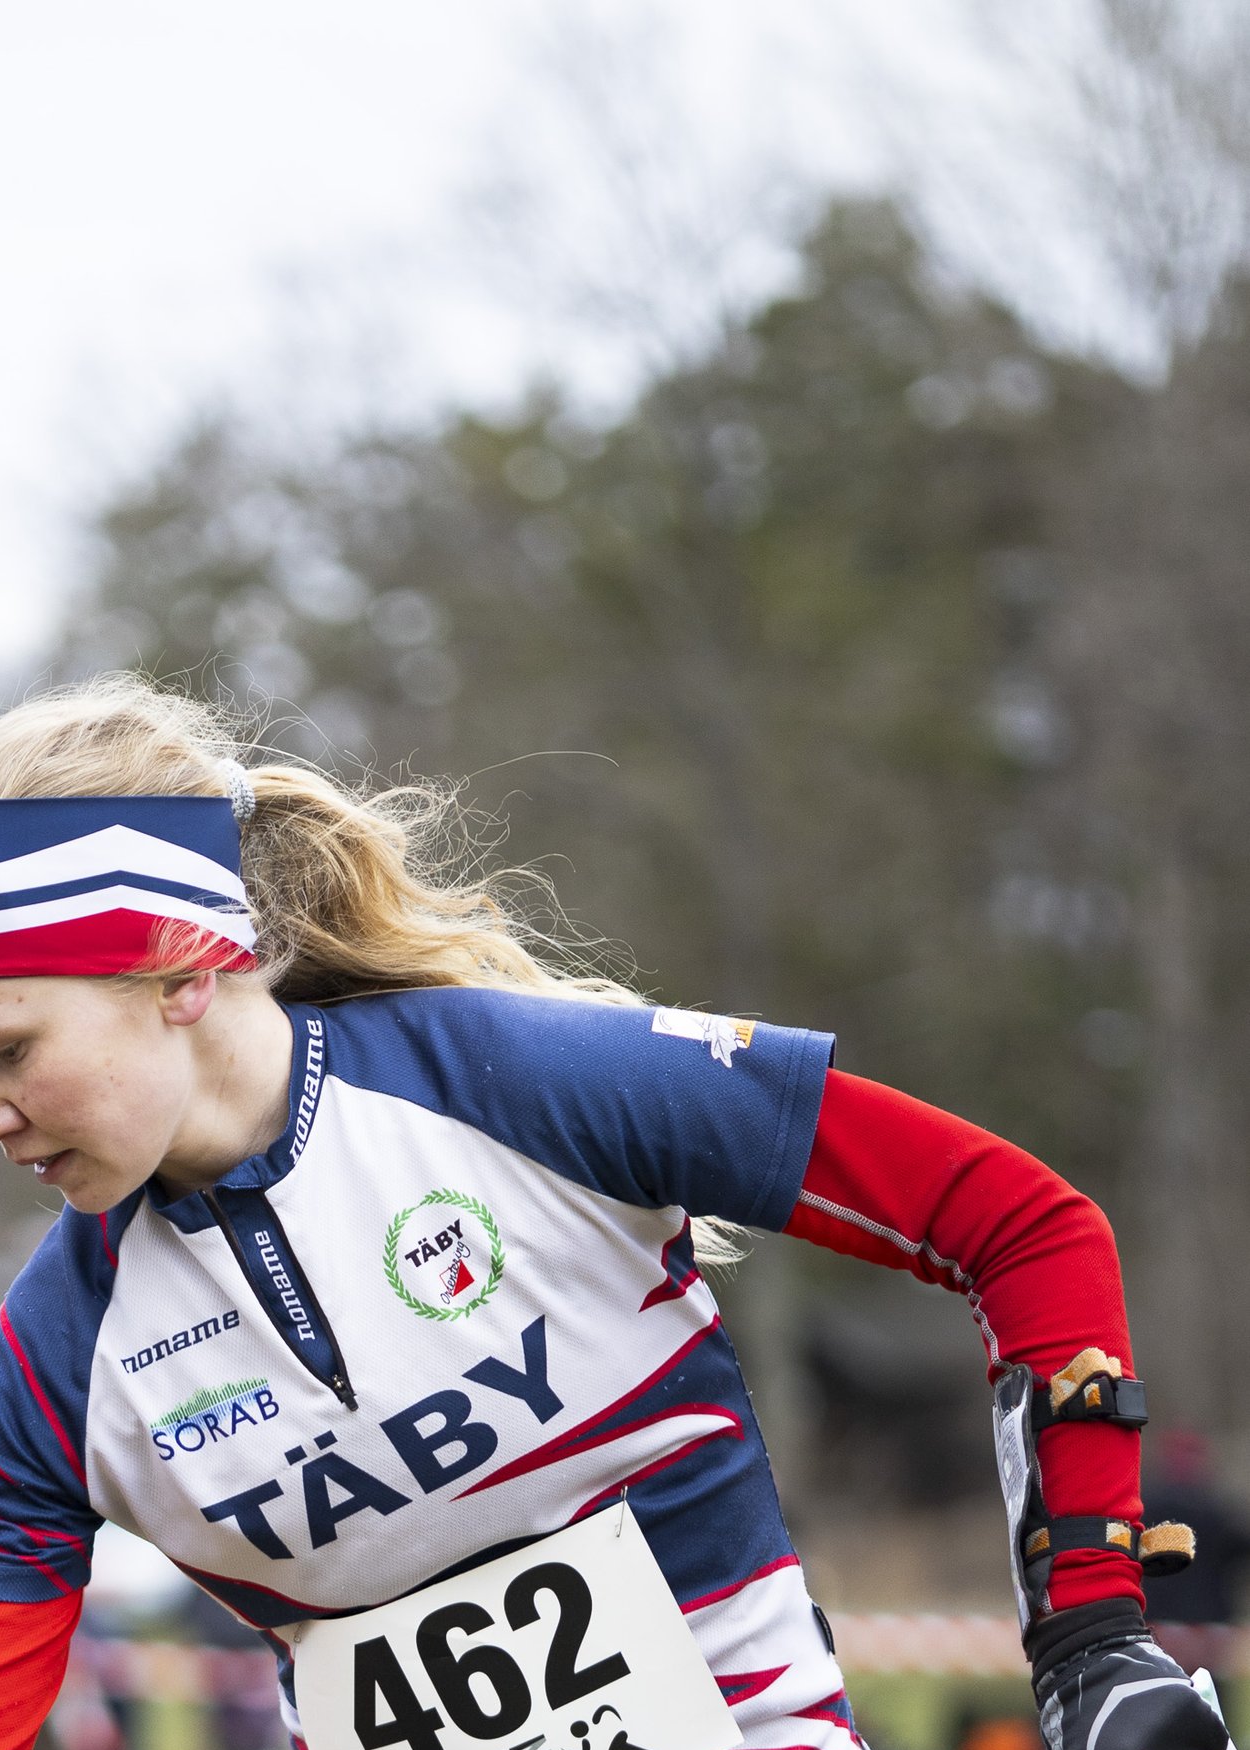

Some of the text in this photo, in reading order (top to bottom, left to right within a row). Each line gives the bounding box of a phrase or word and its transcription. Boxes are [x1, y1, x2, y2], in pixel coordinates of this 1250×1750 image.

[289, 1018, 325, 1166] noname
[254, 1229, 315, 1342] noname
[403, 1217, 464, 1268] TÄBY
[121, 1309, 240, 1375] noname
[200, 1314, 565, 1561] TÄBY
